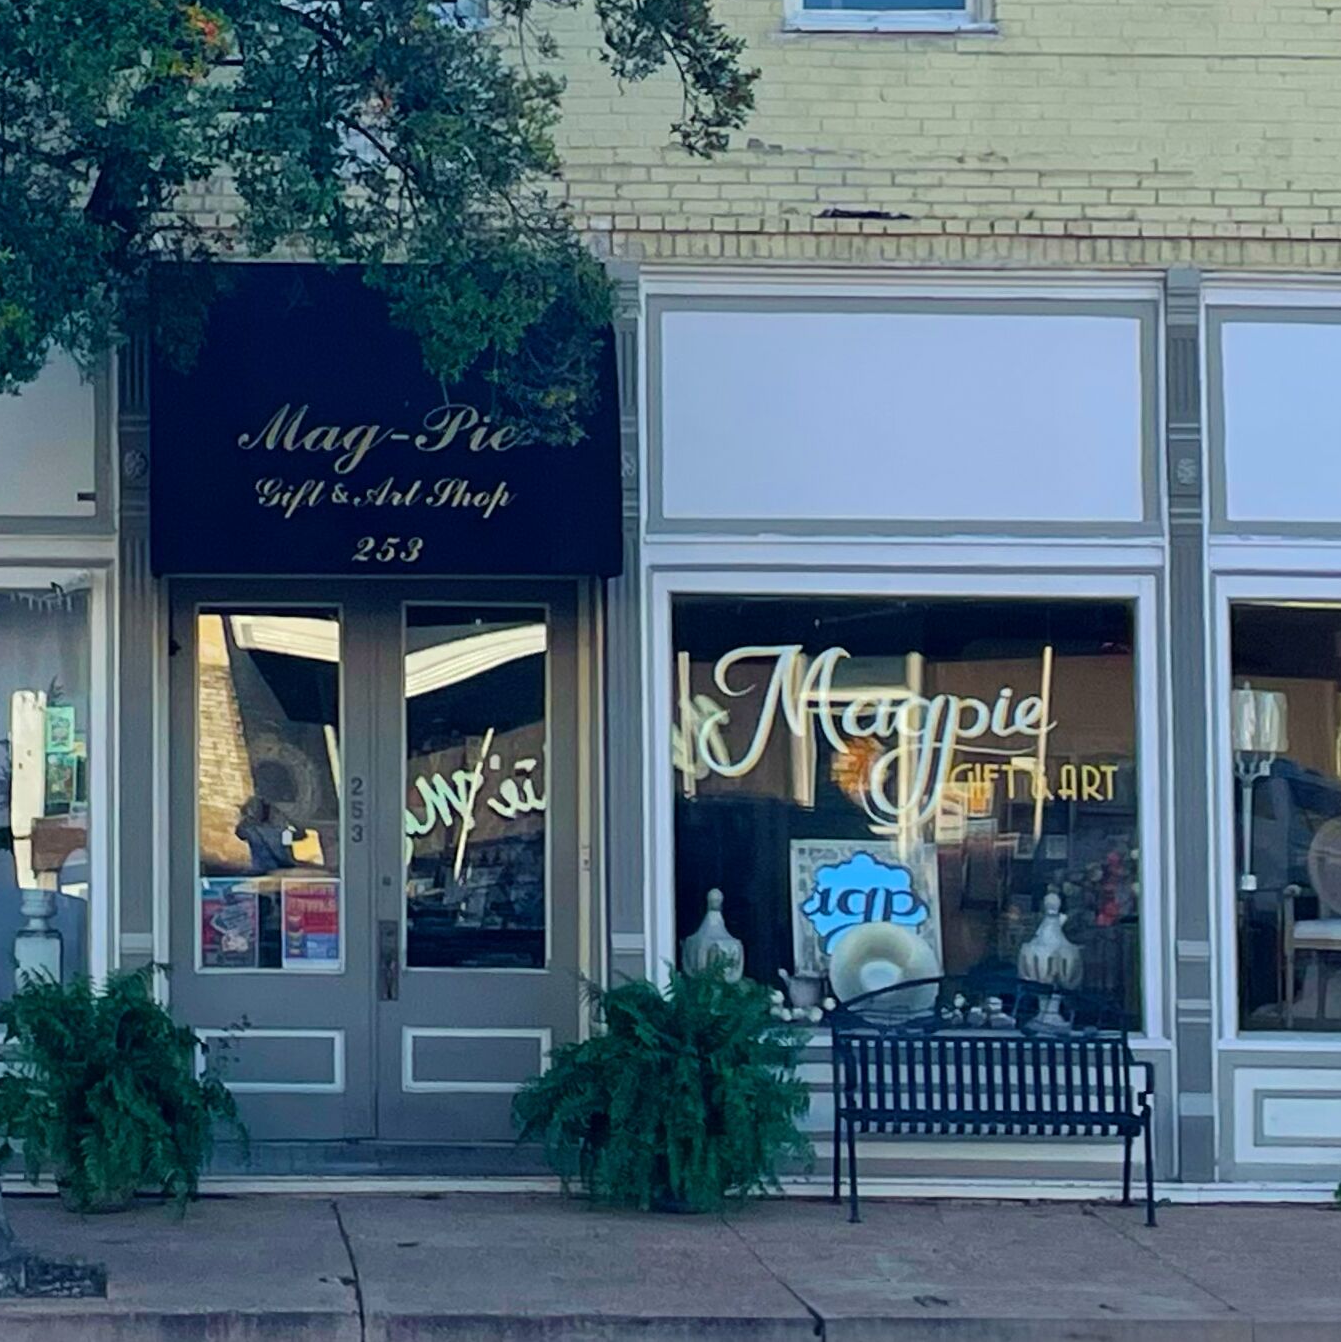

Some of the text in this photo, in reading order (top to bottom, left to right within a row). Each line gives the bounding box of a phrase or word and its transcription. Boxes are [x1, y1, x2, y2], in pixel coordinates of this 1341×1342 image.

[237, 403, 521, 474] Mag-Pie
[255, 476, 517, 519] Gift & Art Shop
[351, 536, 424, 562] 253
[698, 644, 1057, 828] Magpie
[350, 776, 364, 843] 253
[949, 763, 1020, 800] GIFT
[1057, 764, 1120, 802] ART
